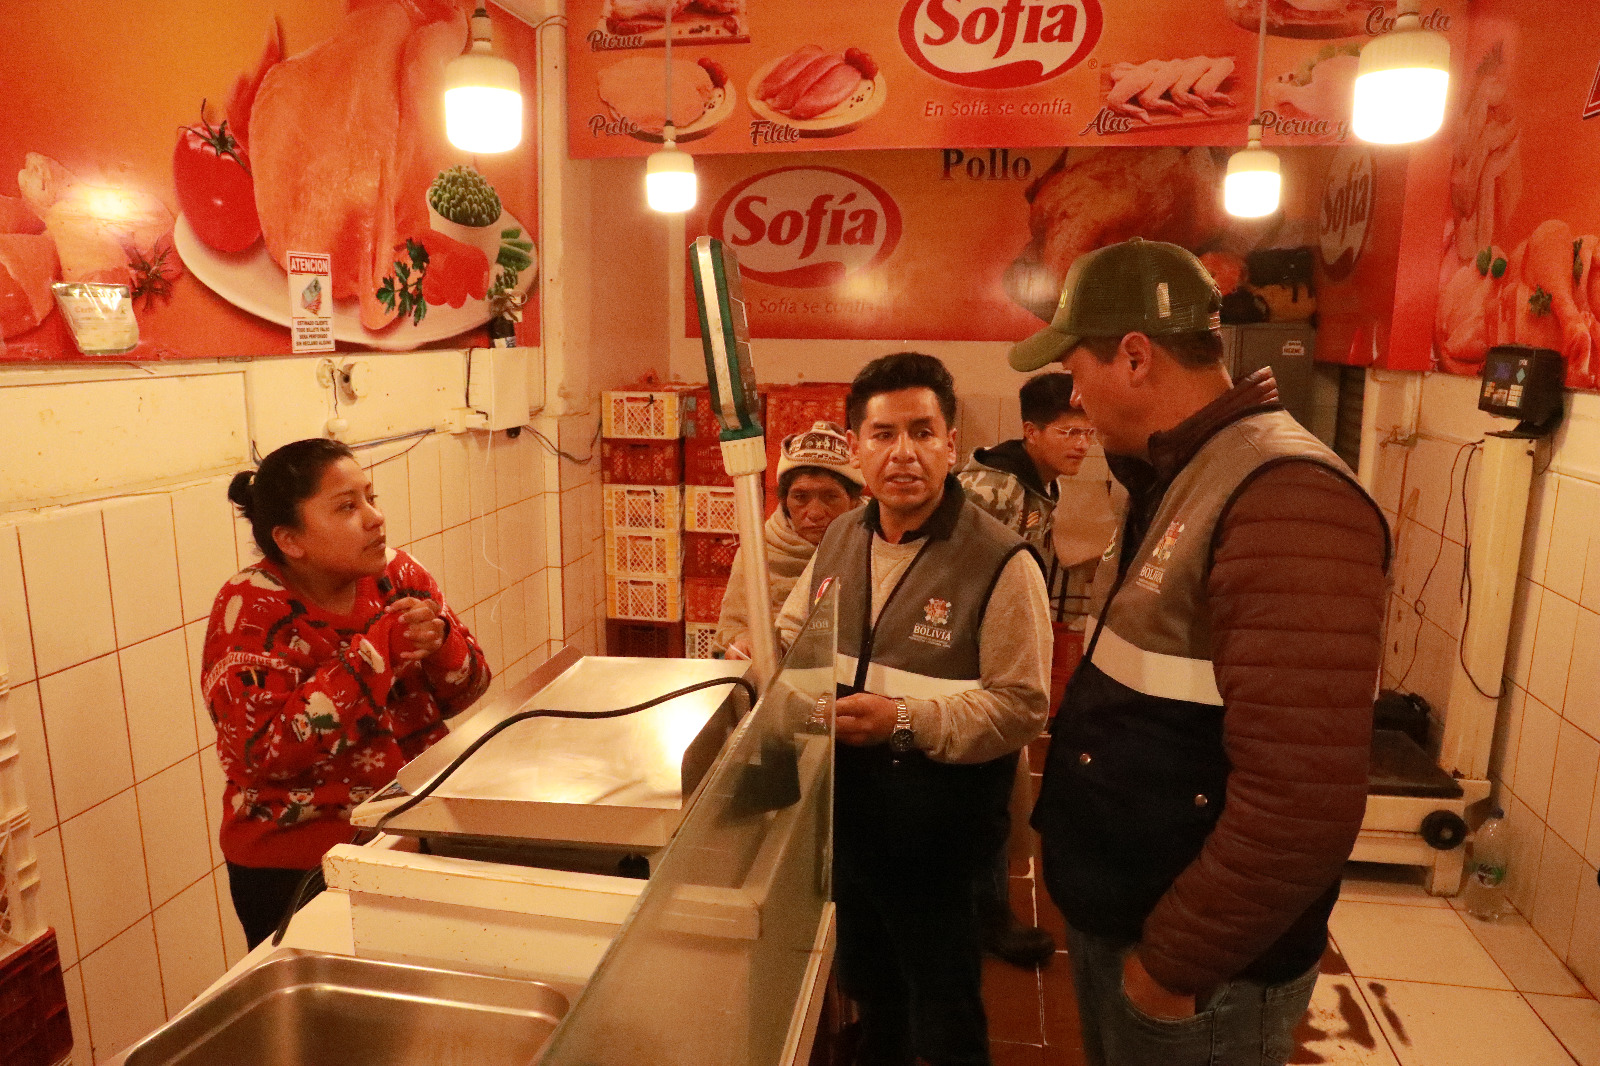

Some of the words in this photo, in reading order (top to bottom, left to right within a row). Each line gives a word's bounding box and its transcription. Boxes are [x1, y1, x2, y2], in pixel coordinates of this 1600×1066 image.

[586, 29, 644, 52] Pierna
[924, 101, 944, 117] En
[951, 100, 990, 117] Sofía
[999, 103, 1015, 116] se
[1020, 100, 1072, 116] confía
[588, 114, 639, 138] Pecho
[750, 120, 800, 146] Filete
[1079, 106, 1133, 136] Alas
[1260, 110, 1330, 137] Pierna
[939, 148, 1032, 181] Pollo
[731, 192, 878, 260] Sofía
[290, 258, 328, 273] ATENCION
[803, 302, 820, 313] se
[913, 624, 952, 642] BOLIVIA
